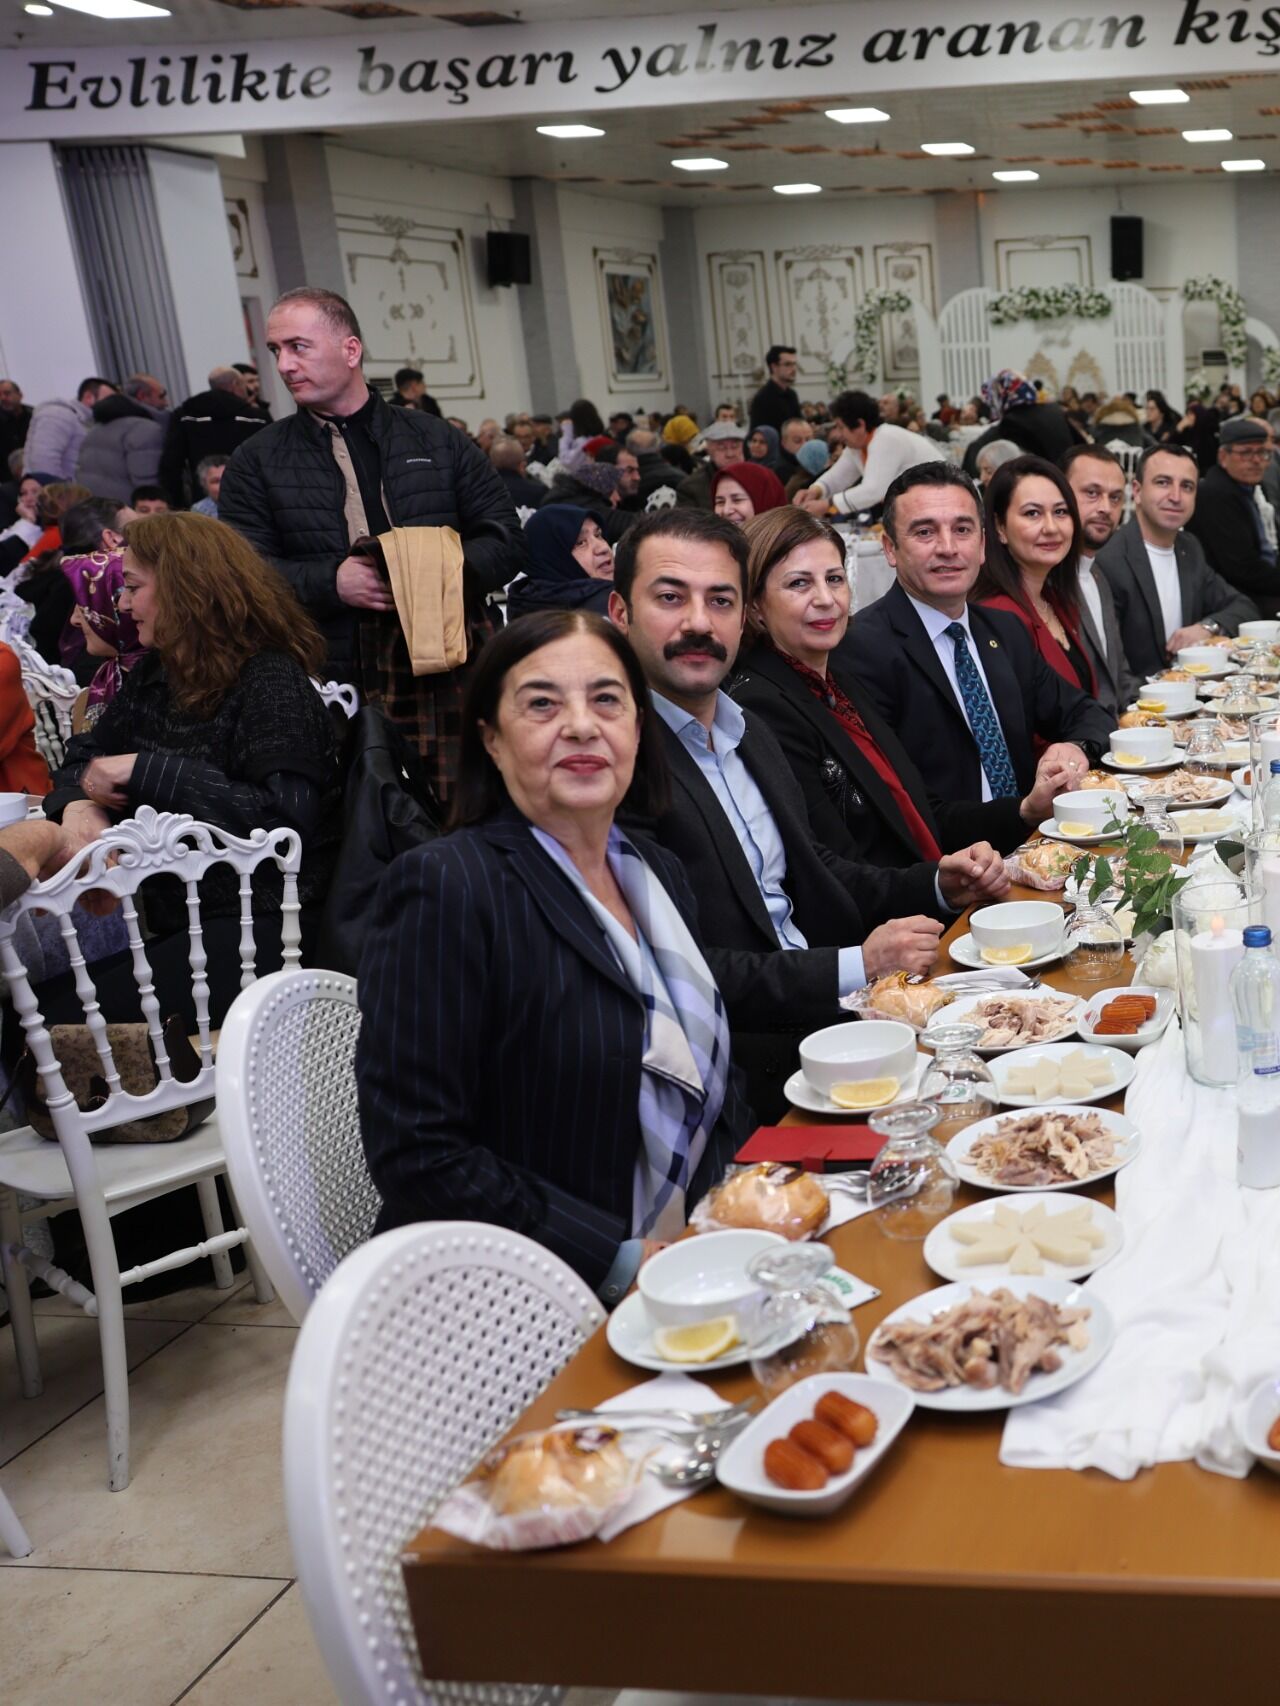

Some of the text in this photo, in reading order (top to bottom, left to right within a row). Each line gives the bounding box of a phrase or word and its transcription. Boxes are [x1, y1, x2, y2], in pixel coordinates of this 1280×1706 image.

[24, 53, 332, 111] Evlilikte
[357, 45, 578, 105] başarı
[595, 23, 835, 92] yalnız
[862, 14, 1147, 63] aranan
